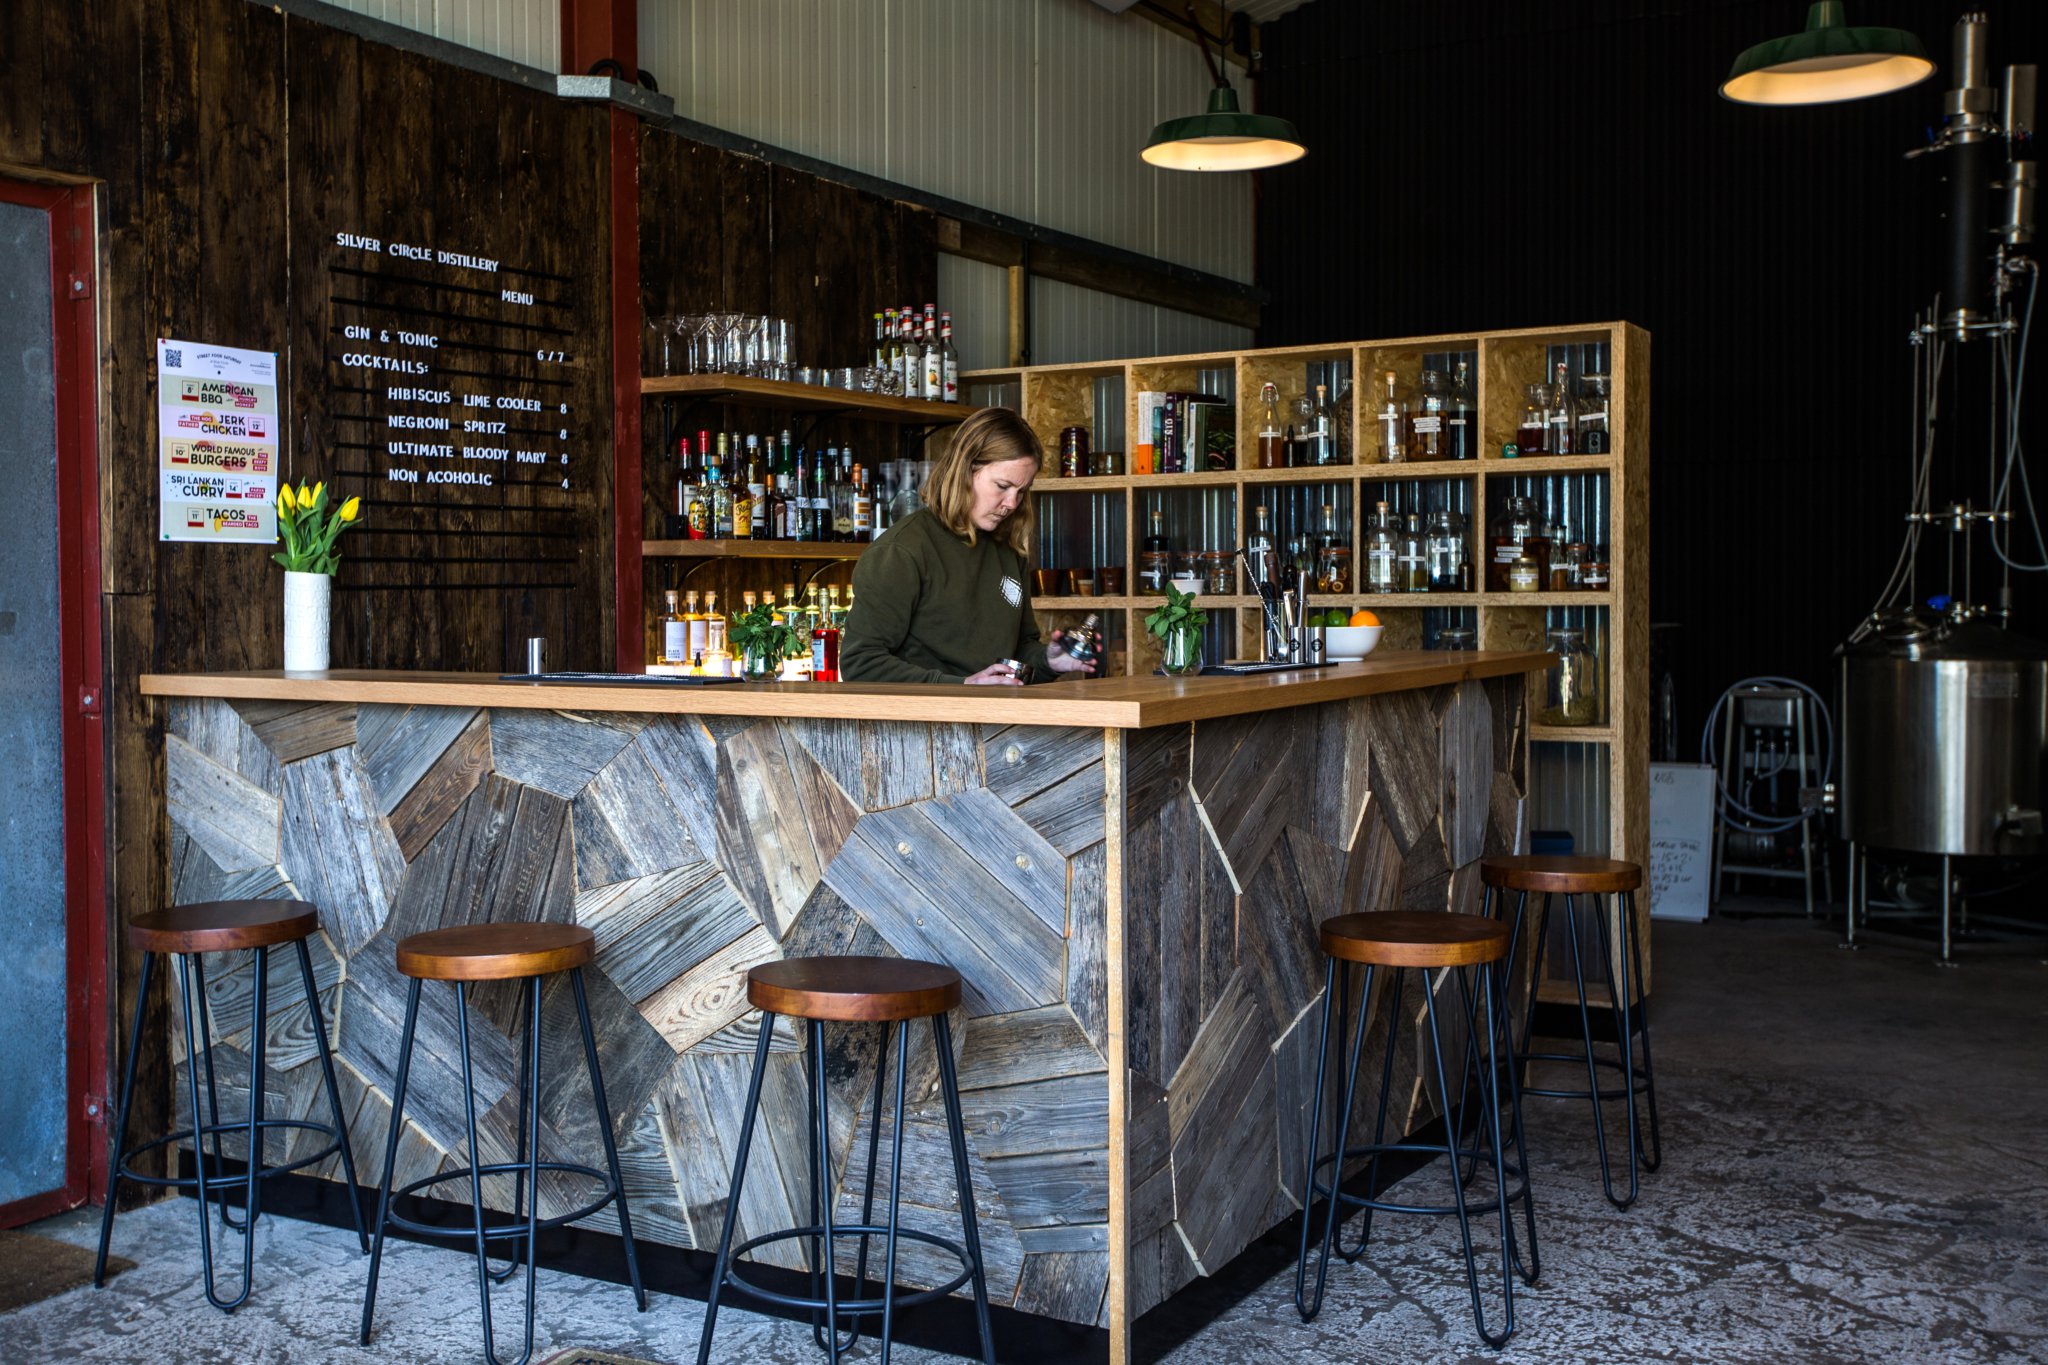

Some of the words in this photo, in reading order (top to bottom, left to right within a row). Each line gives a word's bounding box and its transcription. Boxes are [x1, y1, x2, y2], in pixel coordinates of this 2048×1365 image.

[336, 232, 381, 252] SILVER
[388, 243, 432, 261] CIRCLE
[437, 250, 499, 273] DISTILLERY
[501, 289, 534, 306] MENU
[344, 325, 370, 340] GIN
[380, 329, 390, 343] &
[397, 331, 438, 349] TONIC
[342, 352, 429, 375] COCKTAILS:
[201, 383, 254, 396] AMERICAN
[201, 393, 223, 404] BBQ
[387, 386, 451, 404] HIBISCUS
[463, 393, 491, 408] LIME
[496, 396, 541, 412] COOLER
[560, 403, 567, 415] 8
[219, 415, 245, 425] JERK
[388, 414, 449, 431] NEGRONI
[463, 419, 506, 435] SPRITZ
[559, 428, 567, 440] 8
[201, 425, 246, 436] CHICKEN
[191, 444, 222, 454] WORLD
[224, 447, 255, 456] FAMOUS
[388, 441, 454, 458] ULTIMATE
[462, 446, 510, 461] BLOODY
[516, 450, 547, 464] MARY
[560, 453, 568, 465] 8
[191, 454, 246, 468] BURGERS
[171, 476, 185, 484] SRI
[188, 476, 224, 486] LANKAN
[388, 468, 418, 483] NON
[426, 470, 493, 487] ACOHOLIC
[561, 478, 569, 489] 4
[183, 486, 224, 498] CURRY
[206, 508, 245, 520] TACOS
